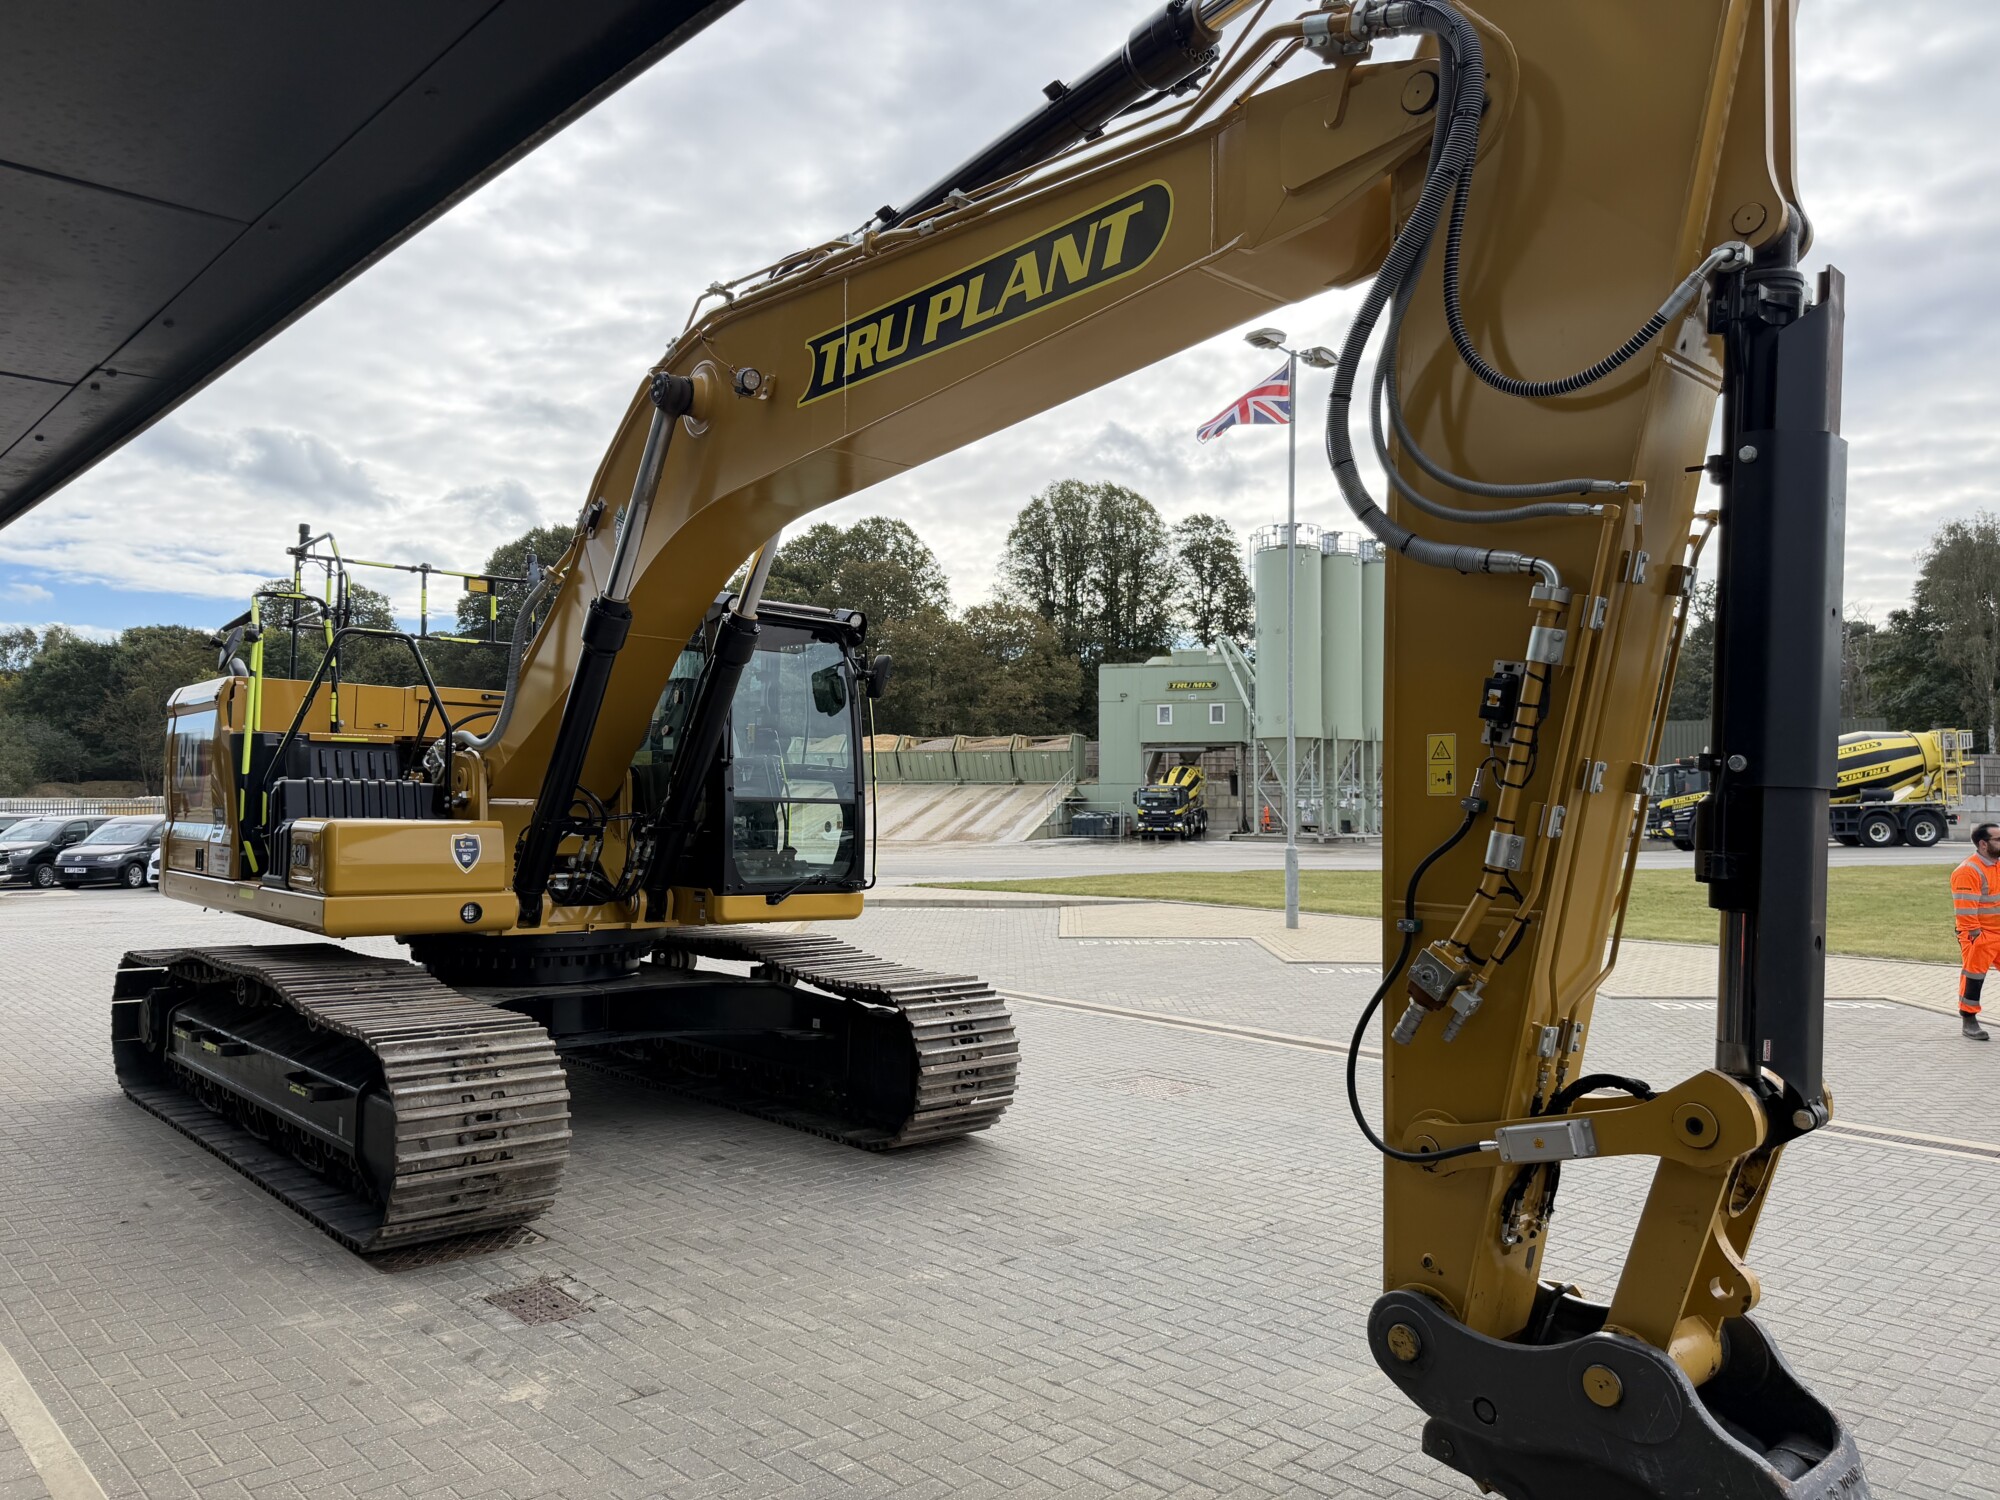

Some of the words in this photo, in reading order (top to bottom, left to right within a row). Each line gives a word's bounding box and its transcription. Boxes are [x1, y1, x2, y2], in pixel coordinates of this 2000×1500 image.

[818, 304, 915, 387] TRU
[921, 200, 1144, 346] PLANT
[1192, 681, 1213, 689] MIX
[1855, 741, 1878, 751] MIX
[177, 732, 201, 789] CAT
[290, 844, 306, 865] 330
